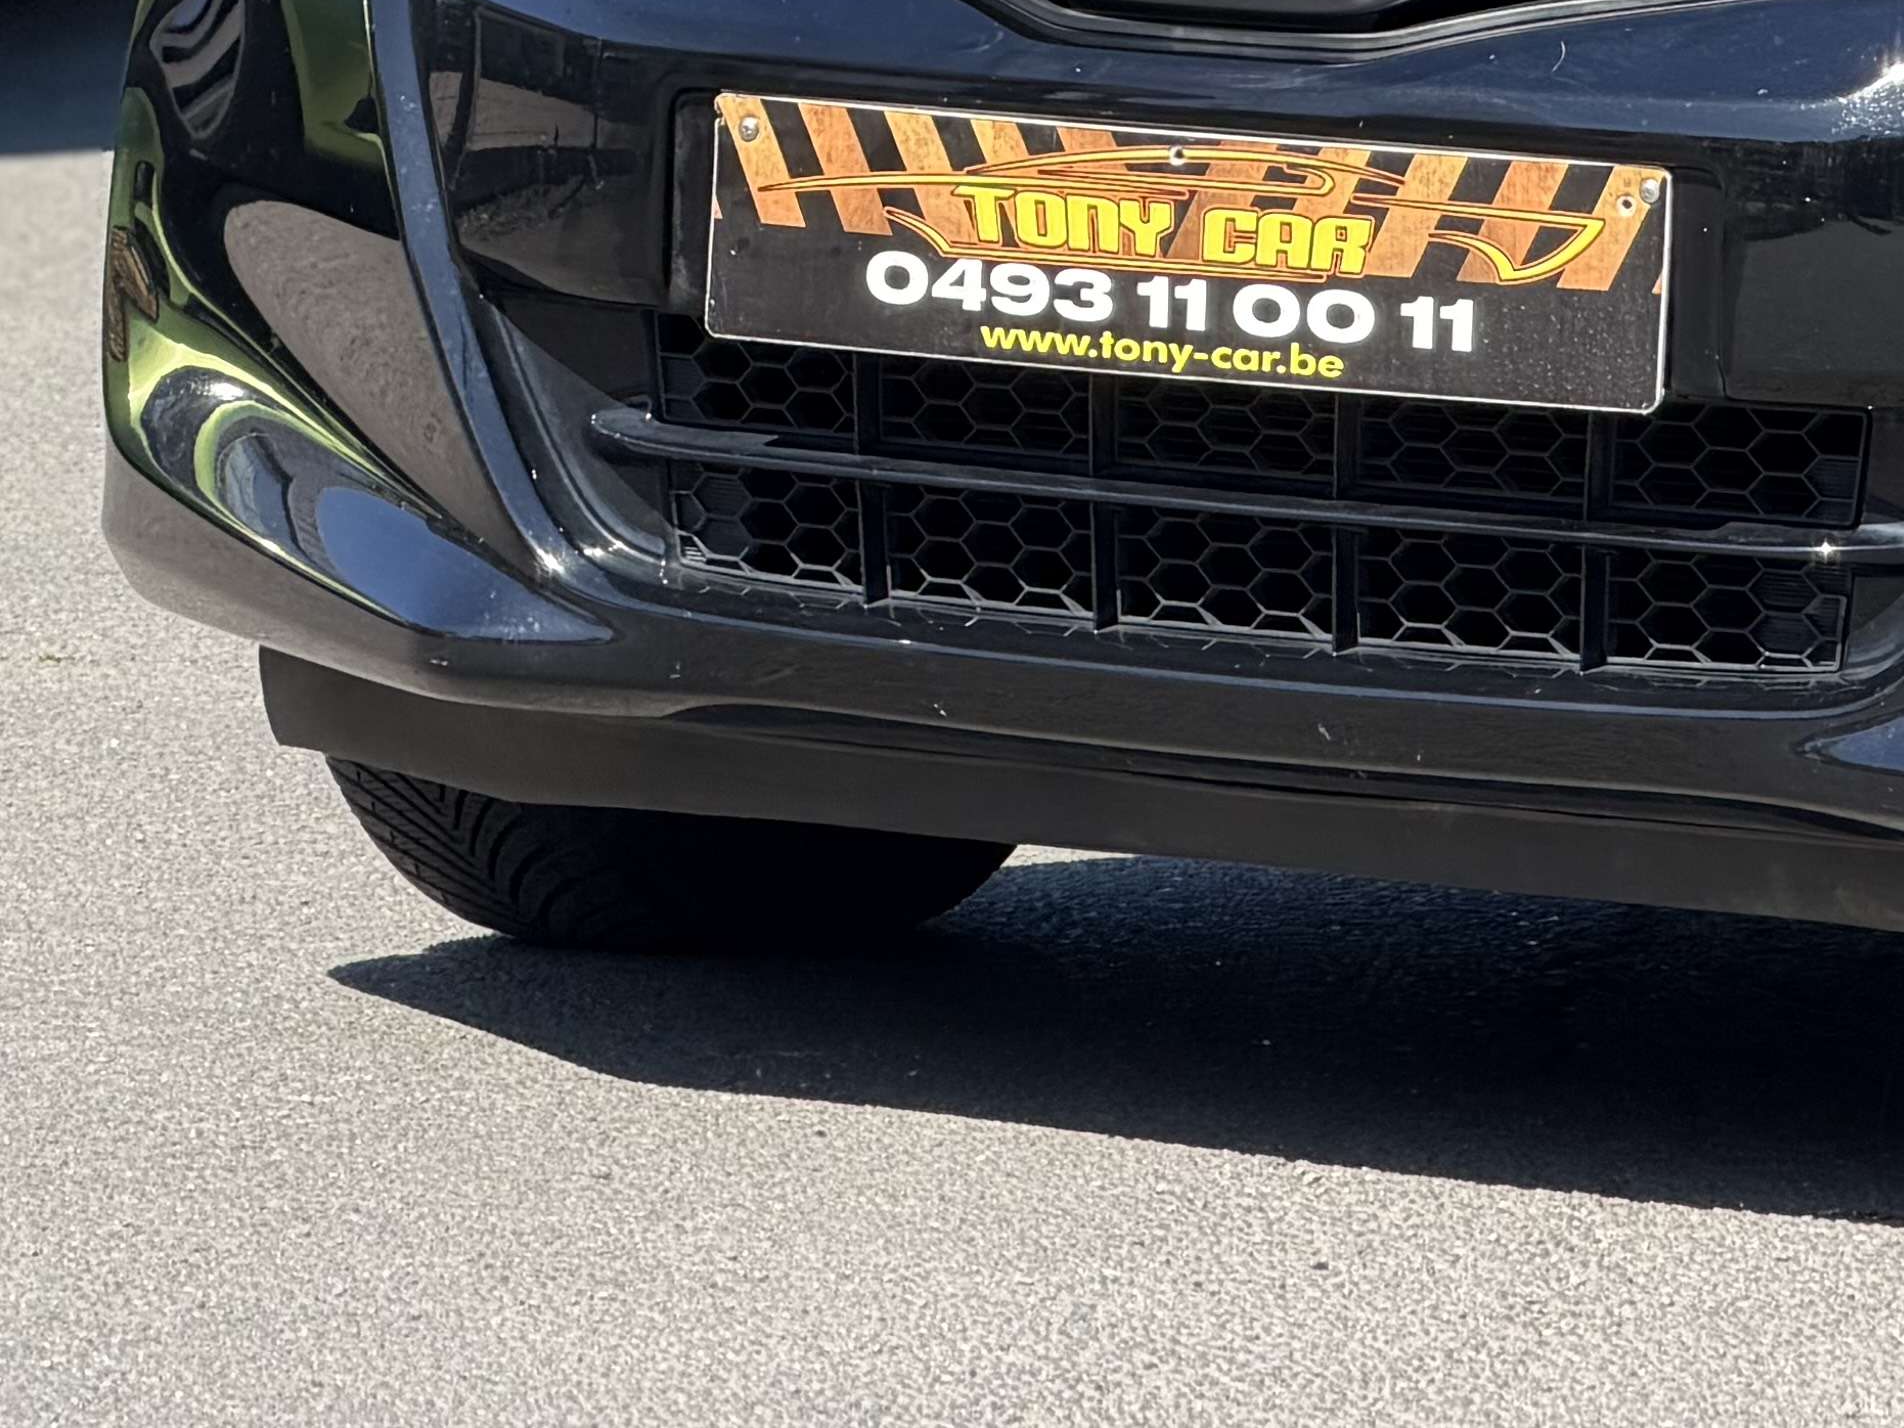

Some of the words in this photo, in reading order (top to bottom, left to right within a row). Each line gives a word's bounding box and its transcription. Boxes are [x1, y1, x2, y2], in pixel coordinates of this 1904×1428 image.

[950, 184, 1174, 258] TONY
[1200, 204, 1376, 275] CAR
[866, 249, 1114, 321] 0493
[1135, 275, 1198, 332] 11
[1399, 294, 1475, 352] 11
[979, 321, 1346, 380] www.tony-car.be
